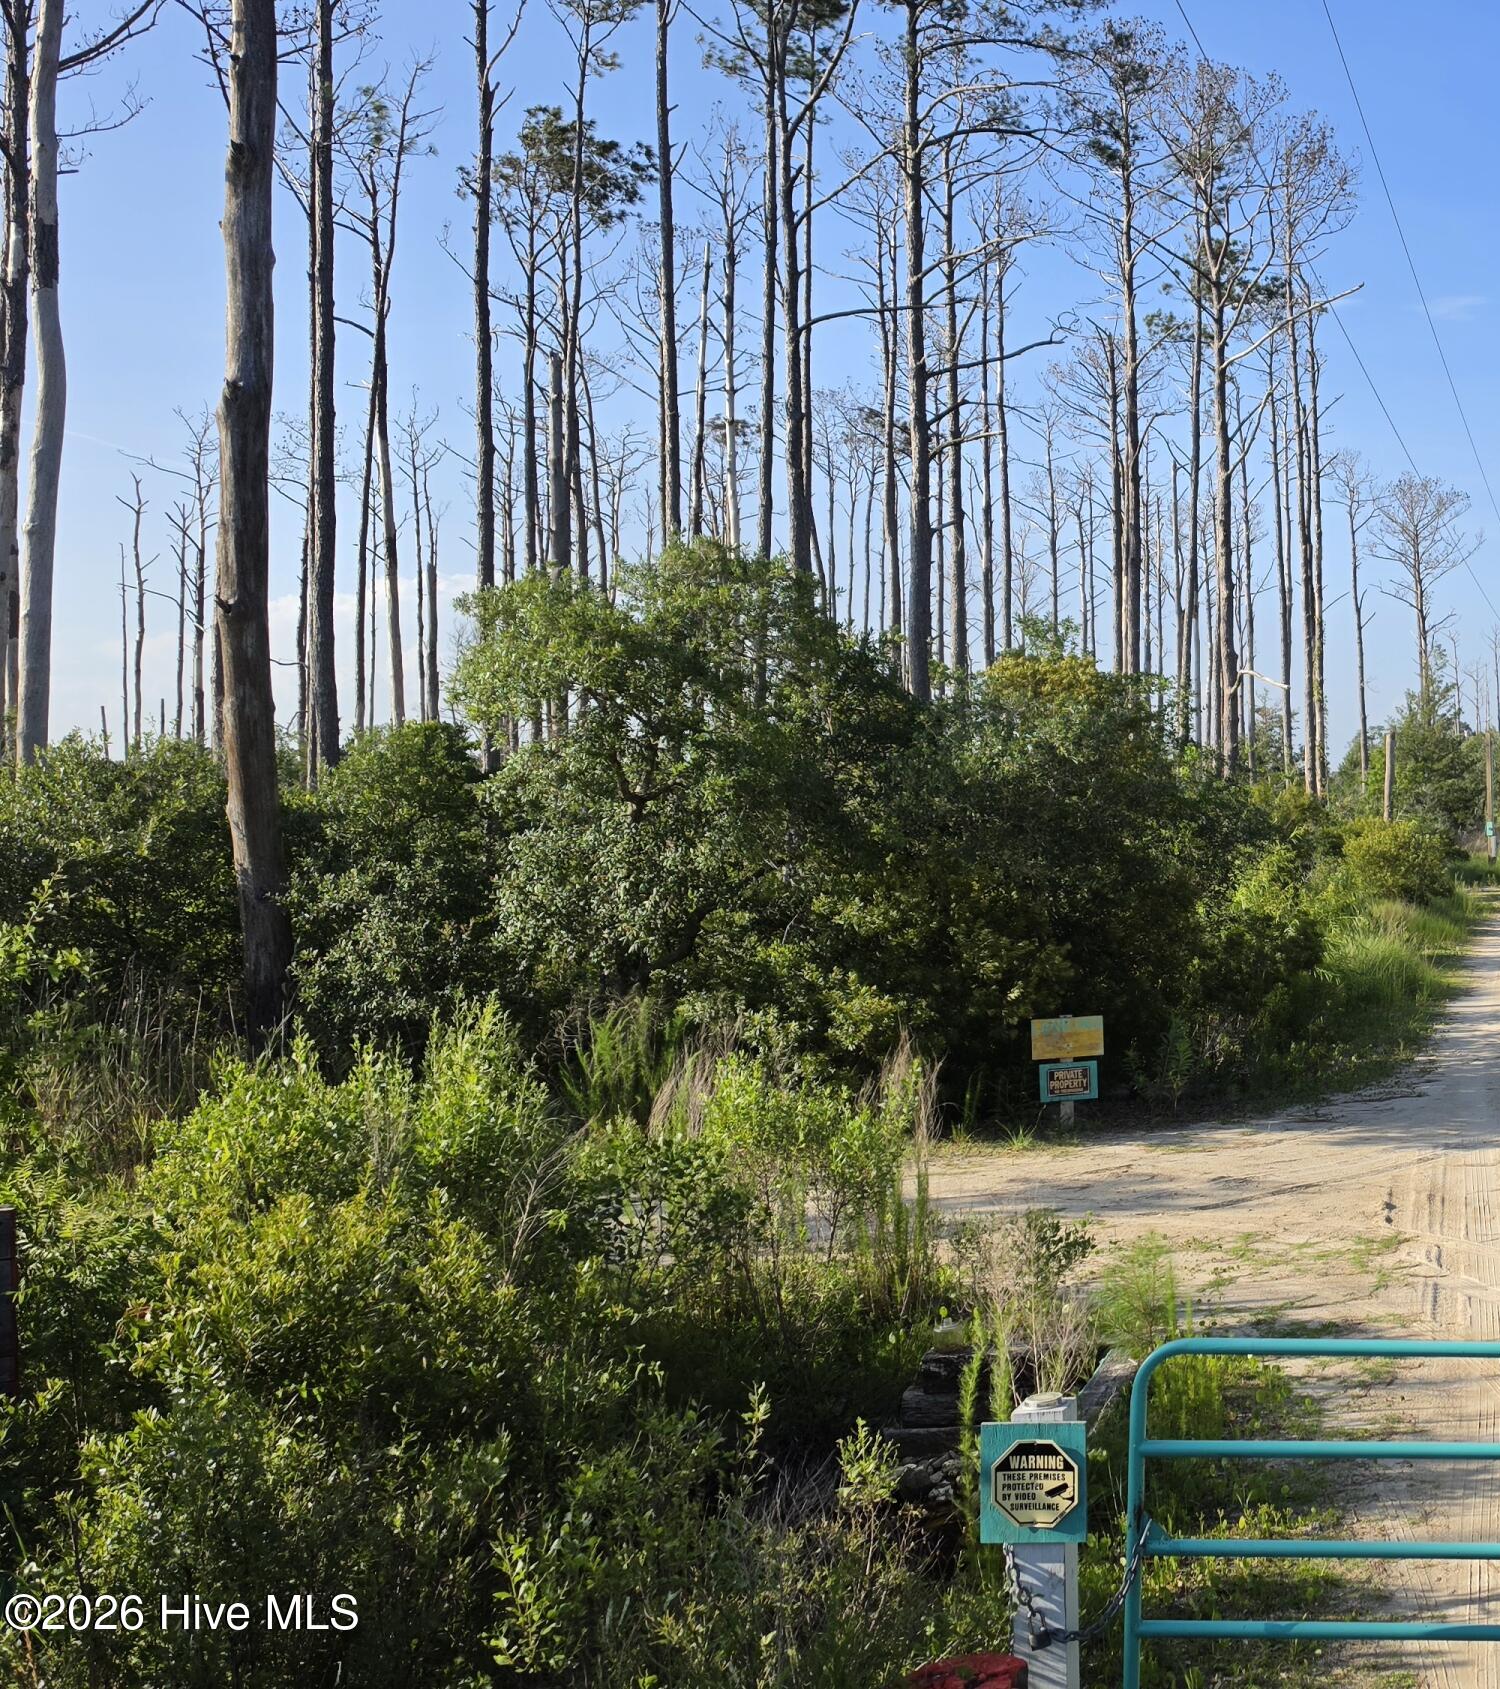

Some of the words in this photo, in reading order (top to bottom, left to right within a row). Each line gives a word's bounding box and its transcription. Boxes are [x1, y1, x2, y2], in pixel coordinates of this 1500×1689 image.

[1054, 1070, 1082, 1080] PRIVATE
[1049, 1079, 1087, 1090] PROPERTY
[1009, 1455, 1064, 1470] WARNING
[1002, 1473, 1026, 1481] THESE
[1029, 1473, 1066, 1481] PREMISES
[1002, 1482, 1044, 1491] PROTECTED
[1002, 1493, 1011, 1501] BY
[1010, 1503, 1060, 1511] SURVEILLANCE
